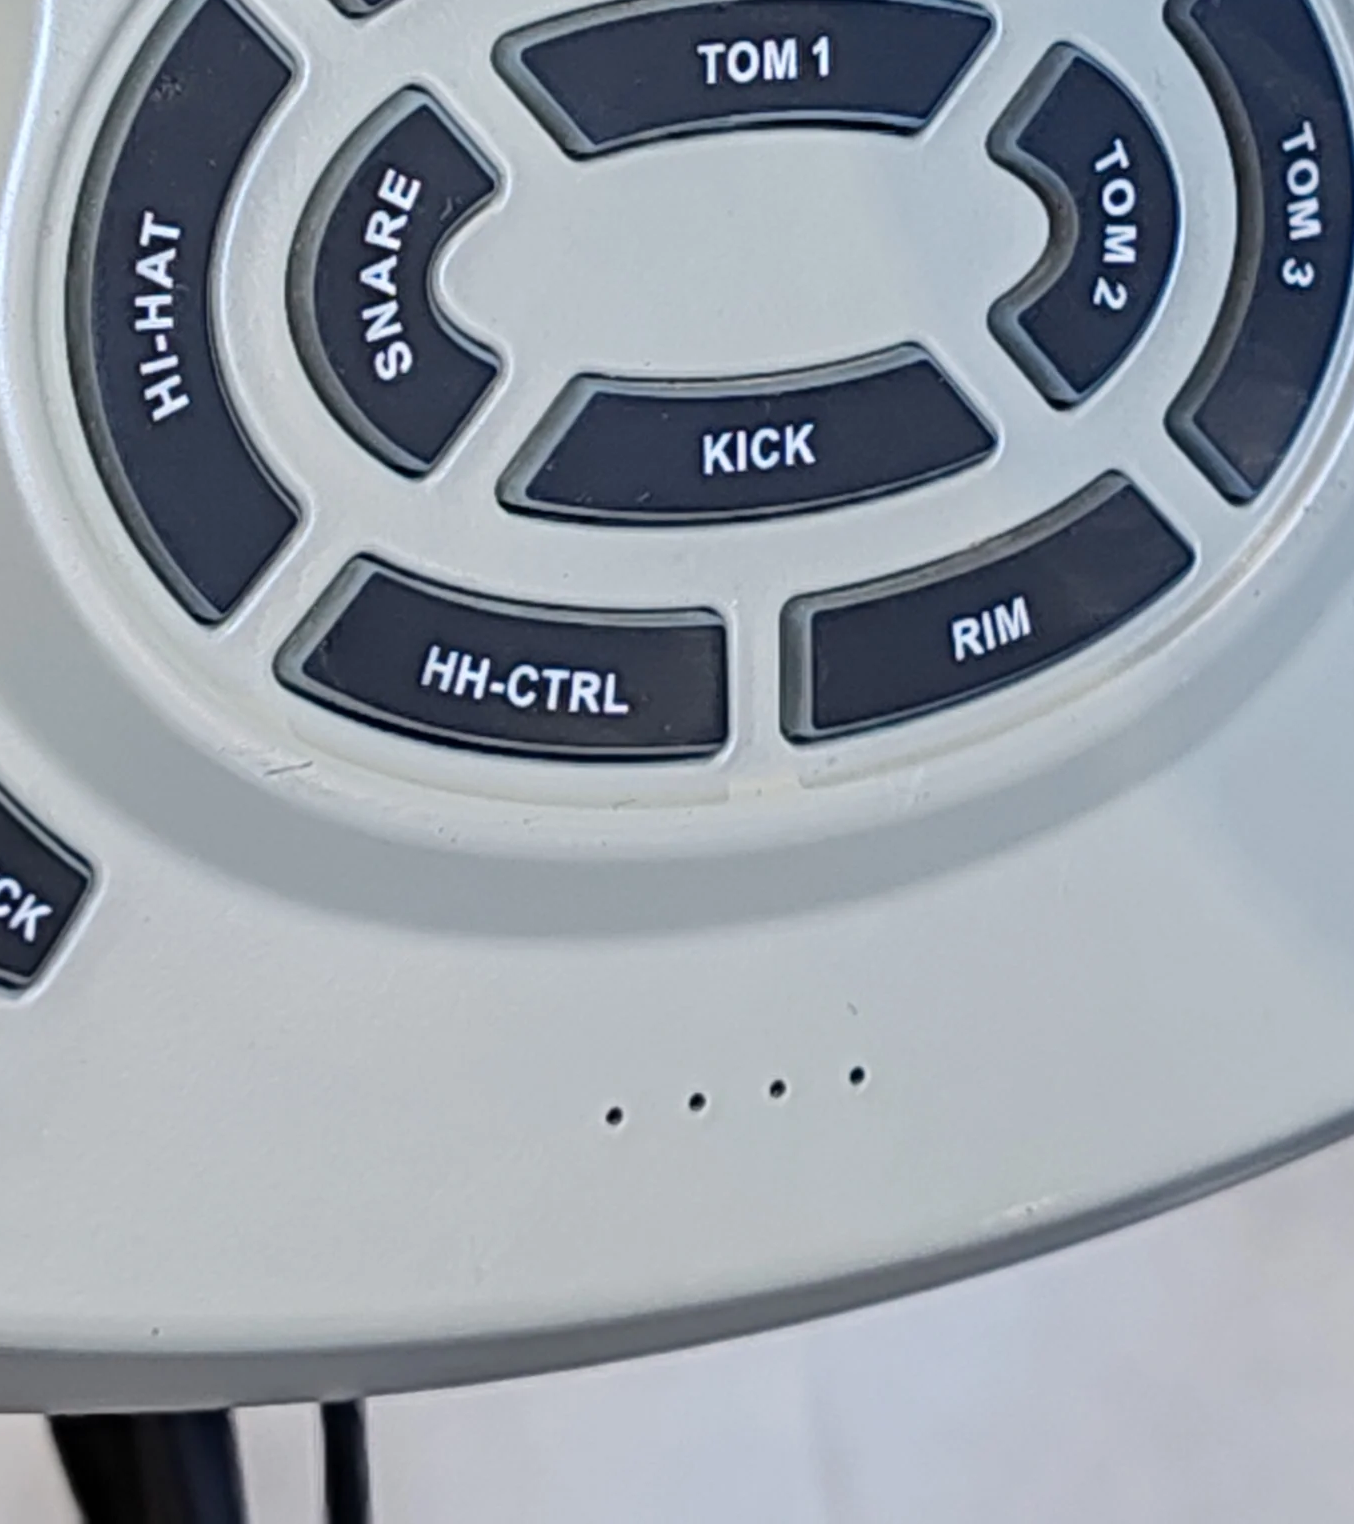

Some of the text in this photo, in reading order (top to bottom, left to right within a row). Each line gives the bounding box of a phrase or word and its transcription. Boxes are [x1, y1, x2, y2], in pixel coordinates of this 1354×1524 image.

[695, 35, 832, 86] TOM 1
[1091, 137, 1138, 312] TOM 2
[1280, 120, 1324, 289] TOM 3
[135, 210, 187, 422] HI-HAT
[373, 167, 423, 382] SNARE
[702, 422, 818, 476] KICK
[419, 644, 631, 716] HH-CTRL
[951, 595, 1033, 663] RIM
